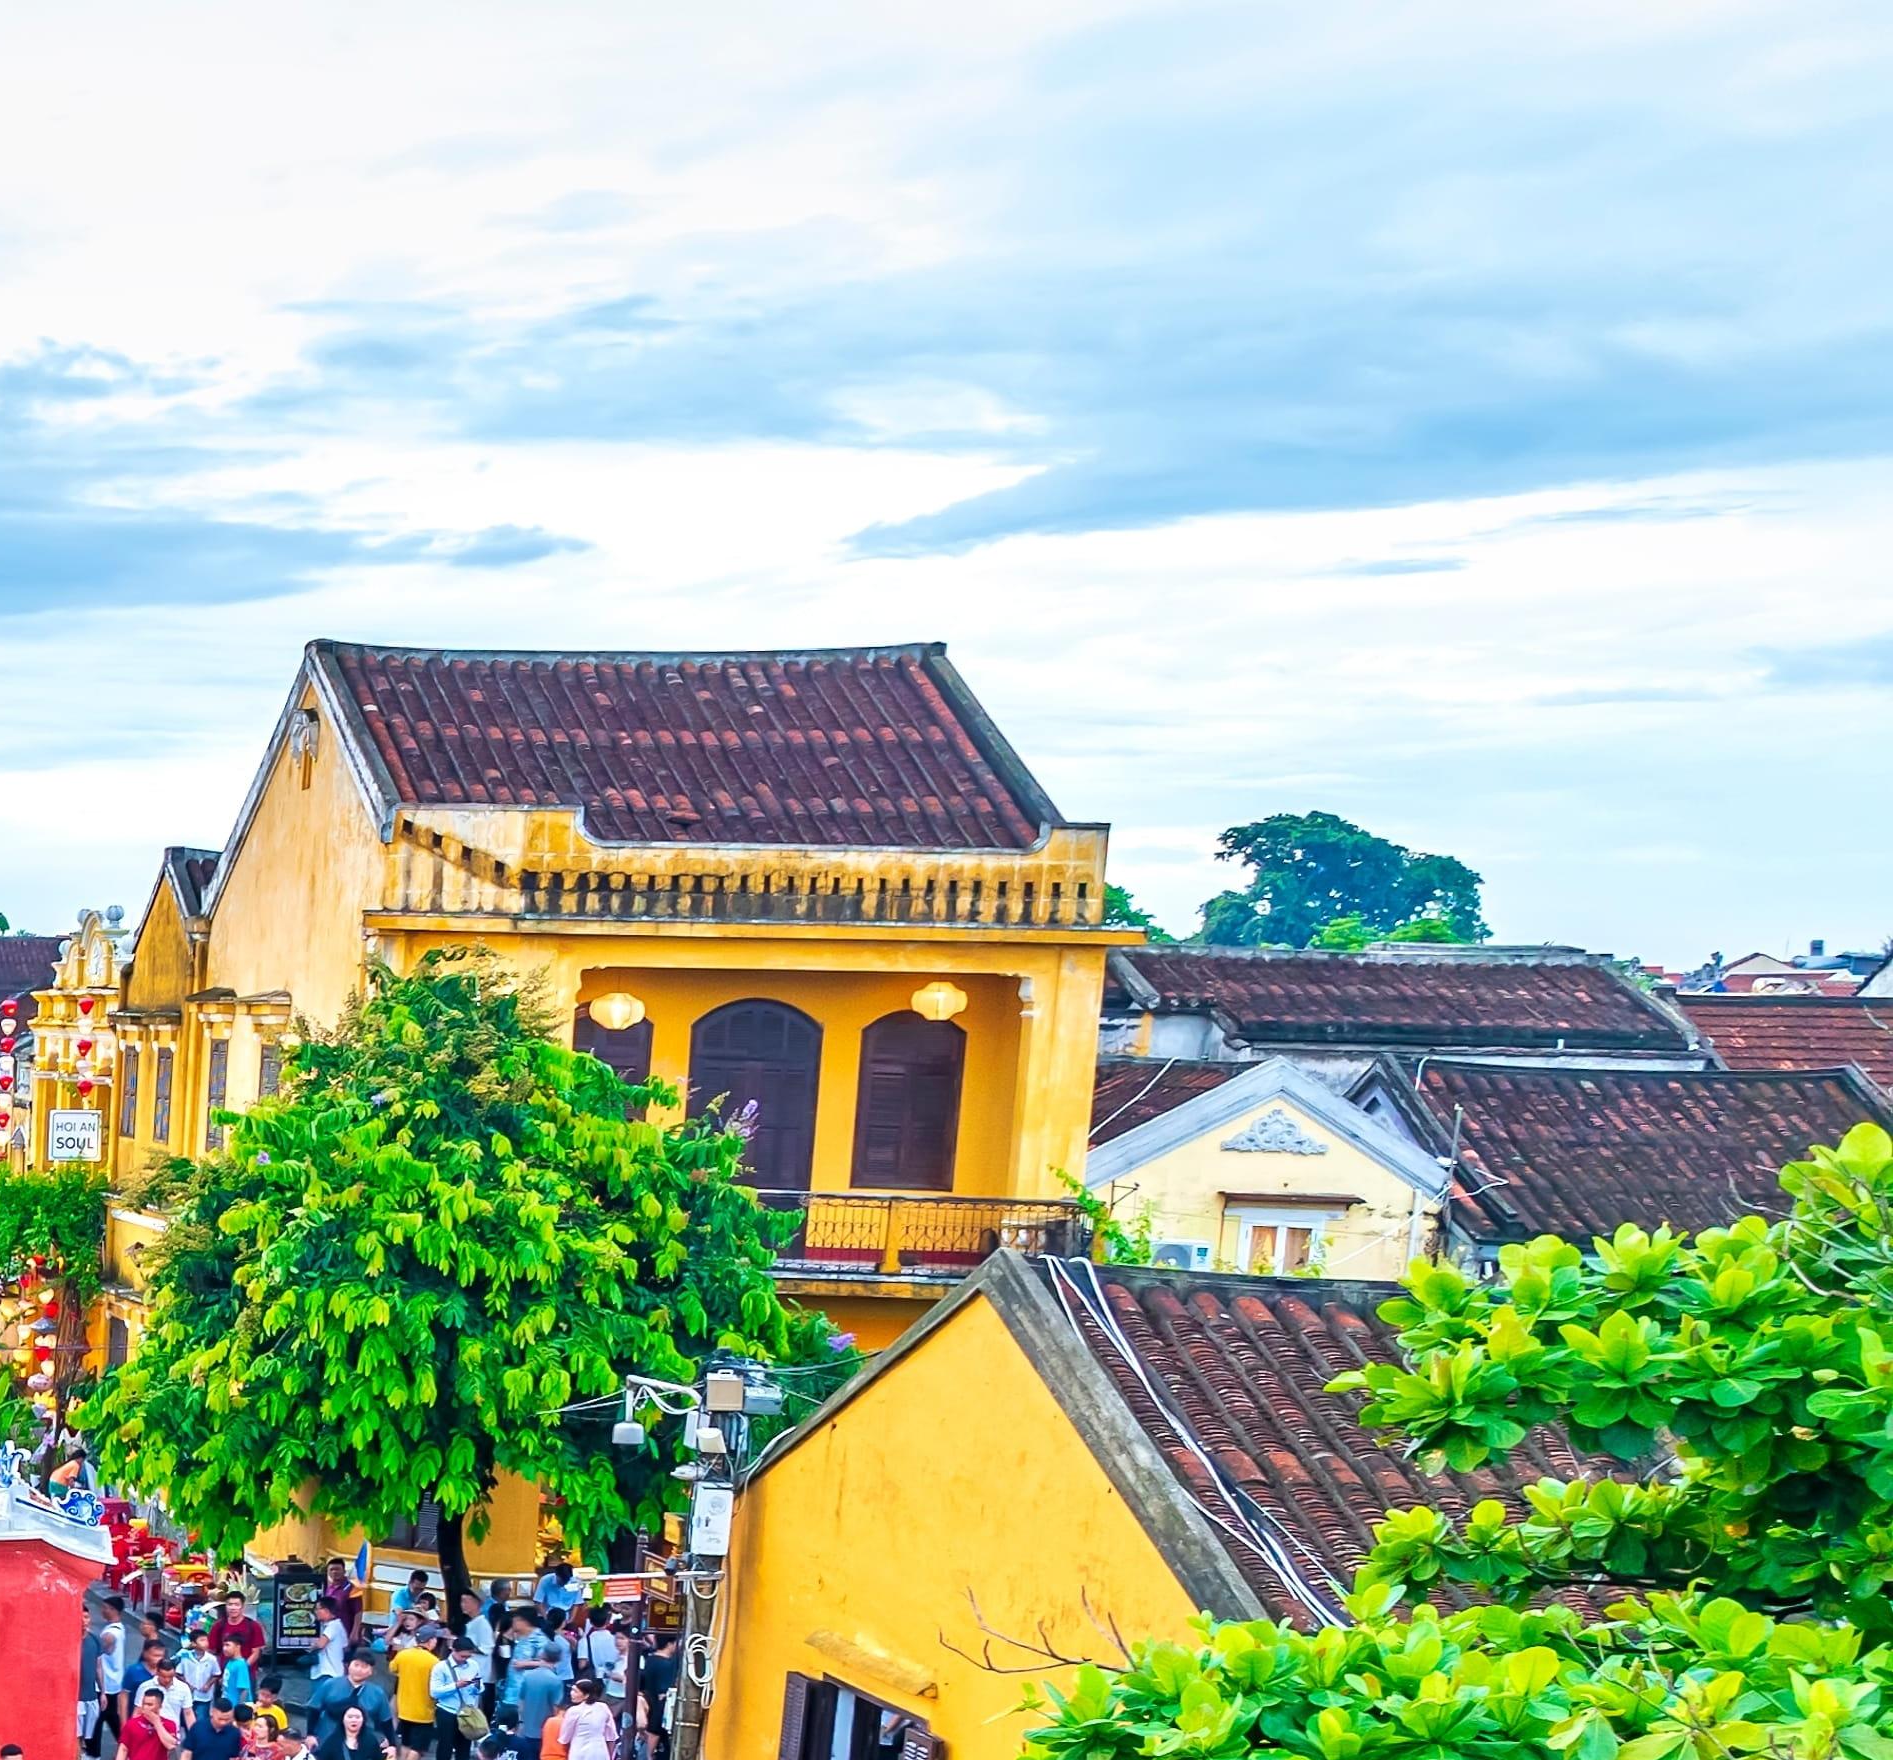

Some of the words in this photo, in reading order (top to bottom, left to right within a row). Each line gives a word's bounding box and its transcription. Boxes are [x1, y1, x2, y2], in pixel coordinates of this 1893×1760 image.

[56, 1122, 76, 1132] HOI
[79, 1122, 96, 1132] AN
[56, 1137, 94, 1149] SOUL
